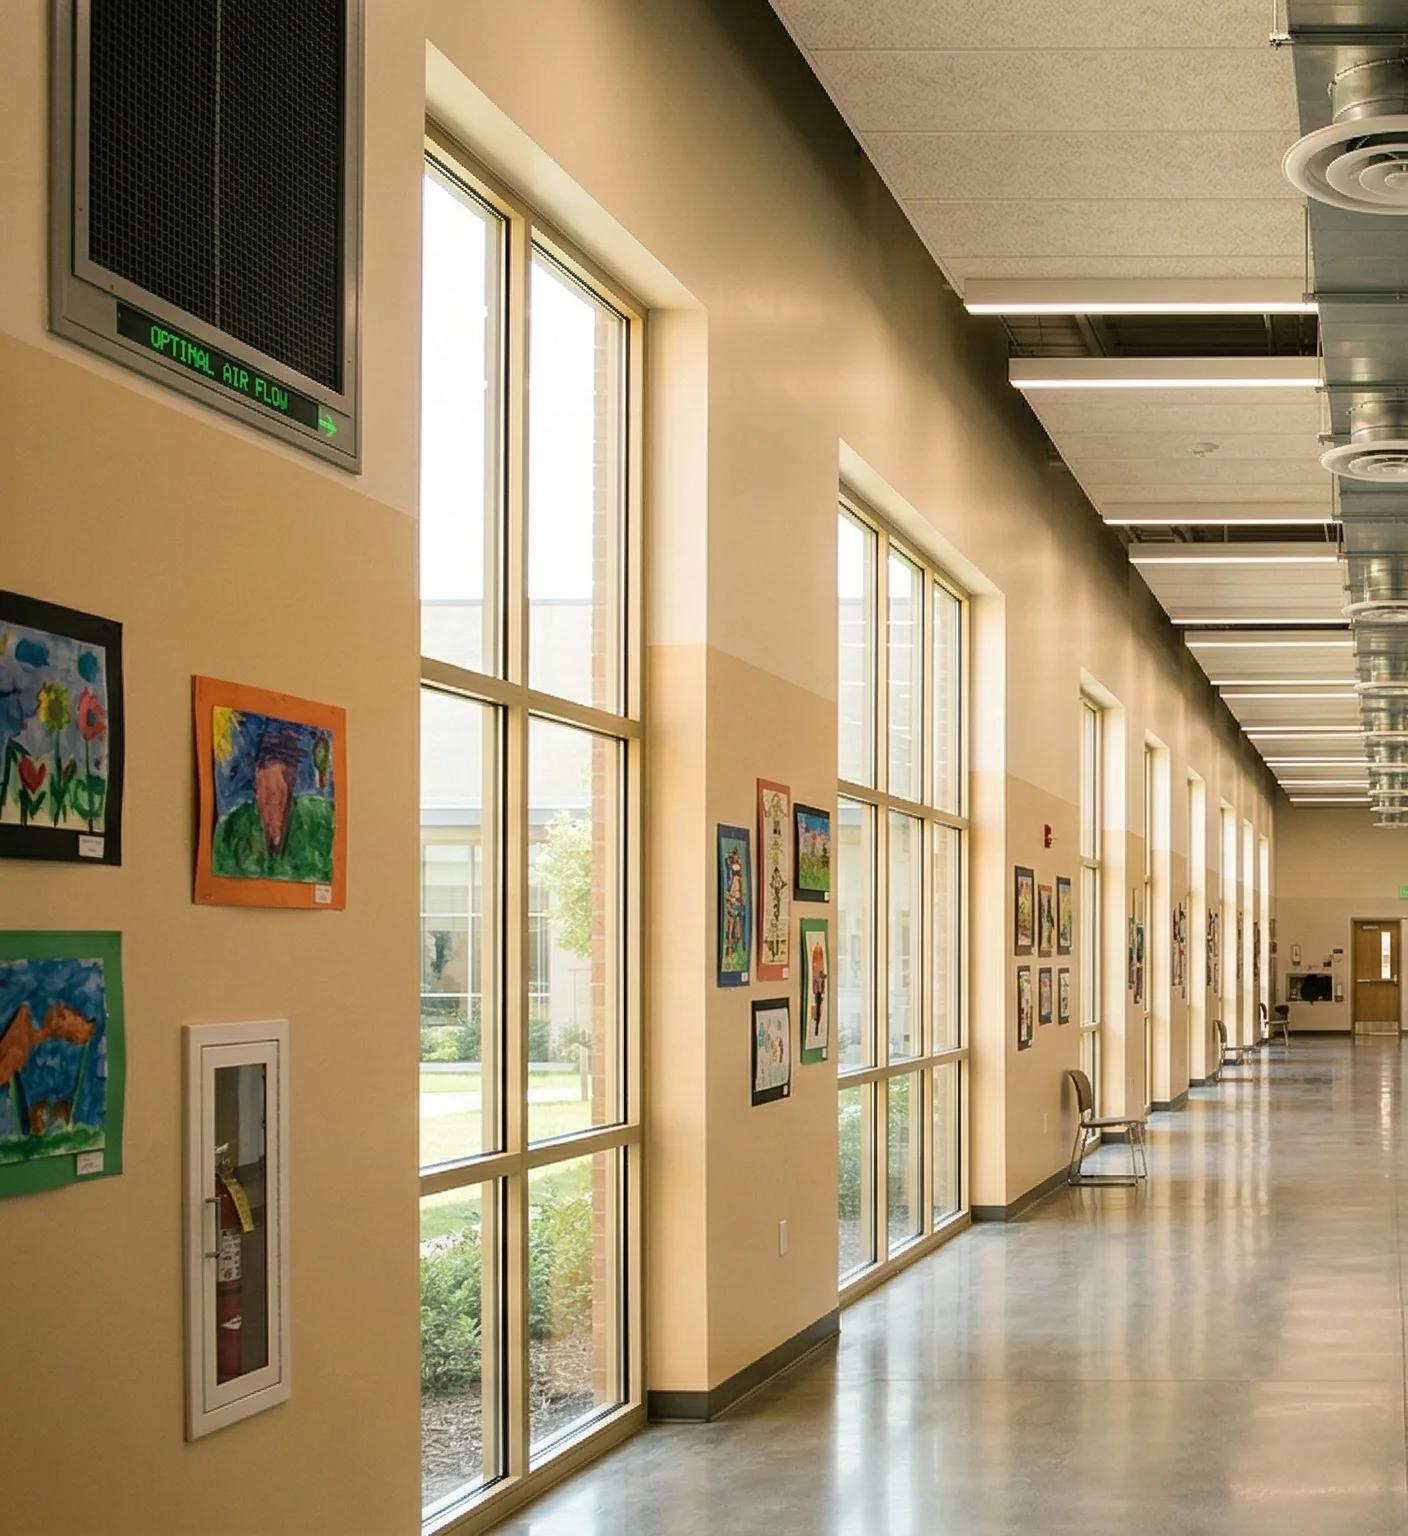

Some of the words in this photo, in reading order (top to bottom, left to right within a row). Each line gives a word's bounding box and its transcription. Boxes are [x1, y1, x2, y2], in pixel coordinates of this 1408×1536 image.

[150, 325, 215, 376] OPTIMAL
[222, 362, 250, 391] AIR
[255, 377, 289, 411] FLOW
